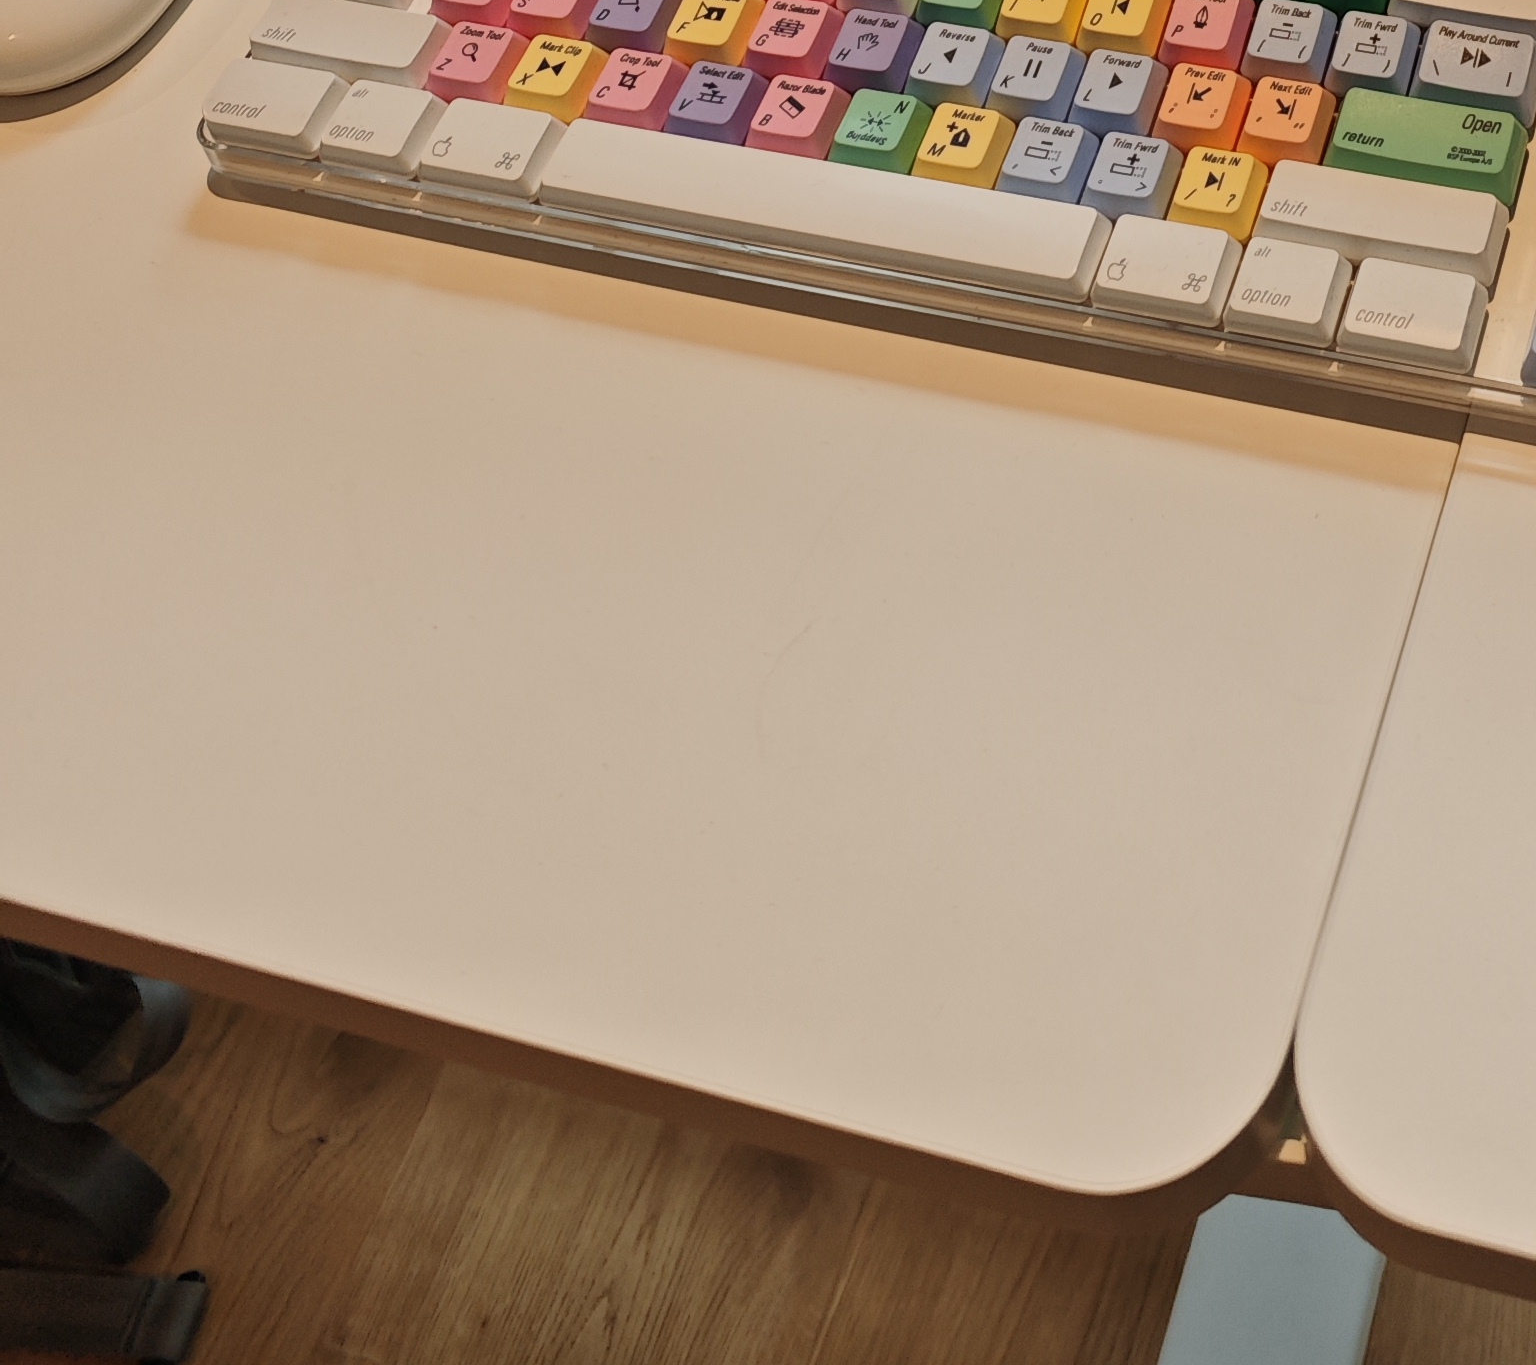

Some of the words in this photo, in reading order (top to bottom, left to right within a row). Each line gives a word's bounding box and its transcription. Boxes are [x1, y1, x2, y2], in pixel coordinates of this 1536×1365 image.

[261, 25, 296, 43] shift
[211, 100, 265, 119] control
[329, 123, 374, 143] option
[1461, 113, 1502, 136] Open
[1342, 130, 1384, 148] return
[1241, 286, 1292, 308] option
